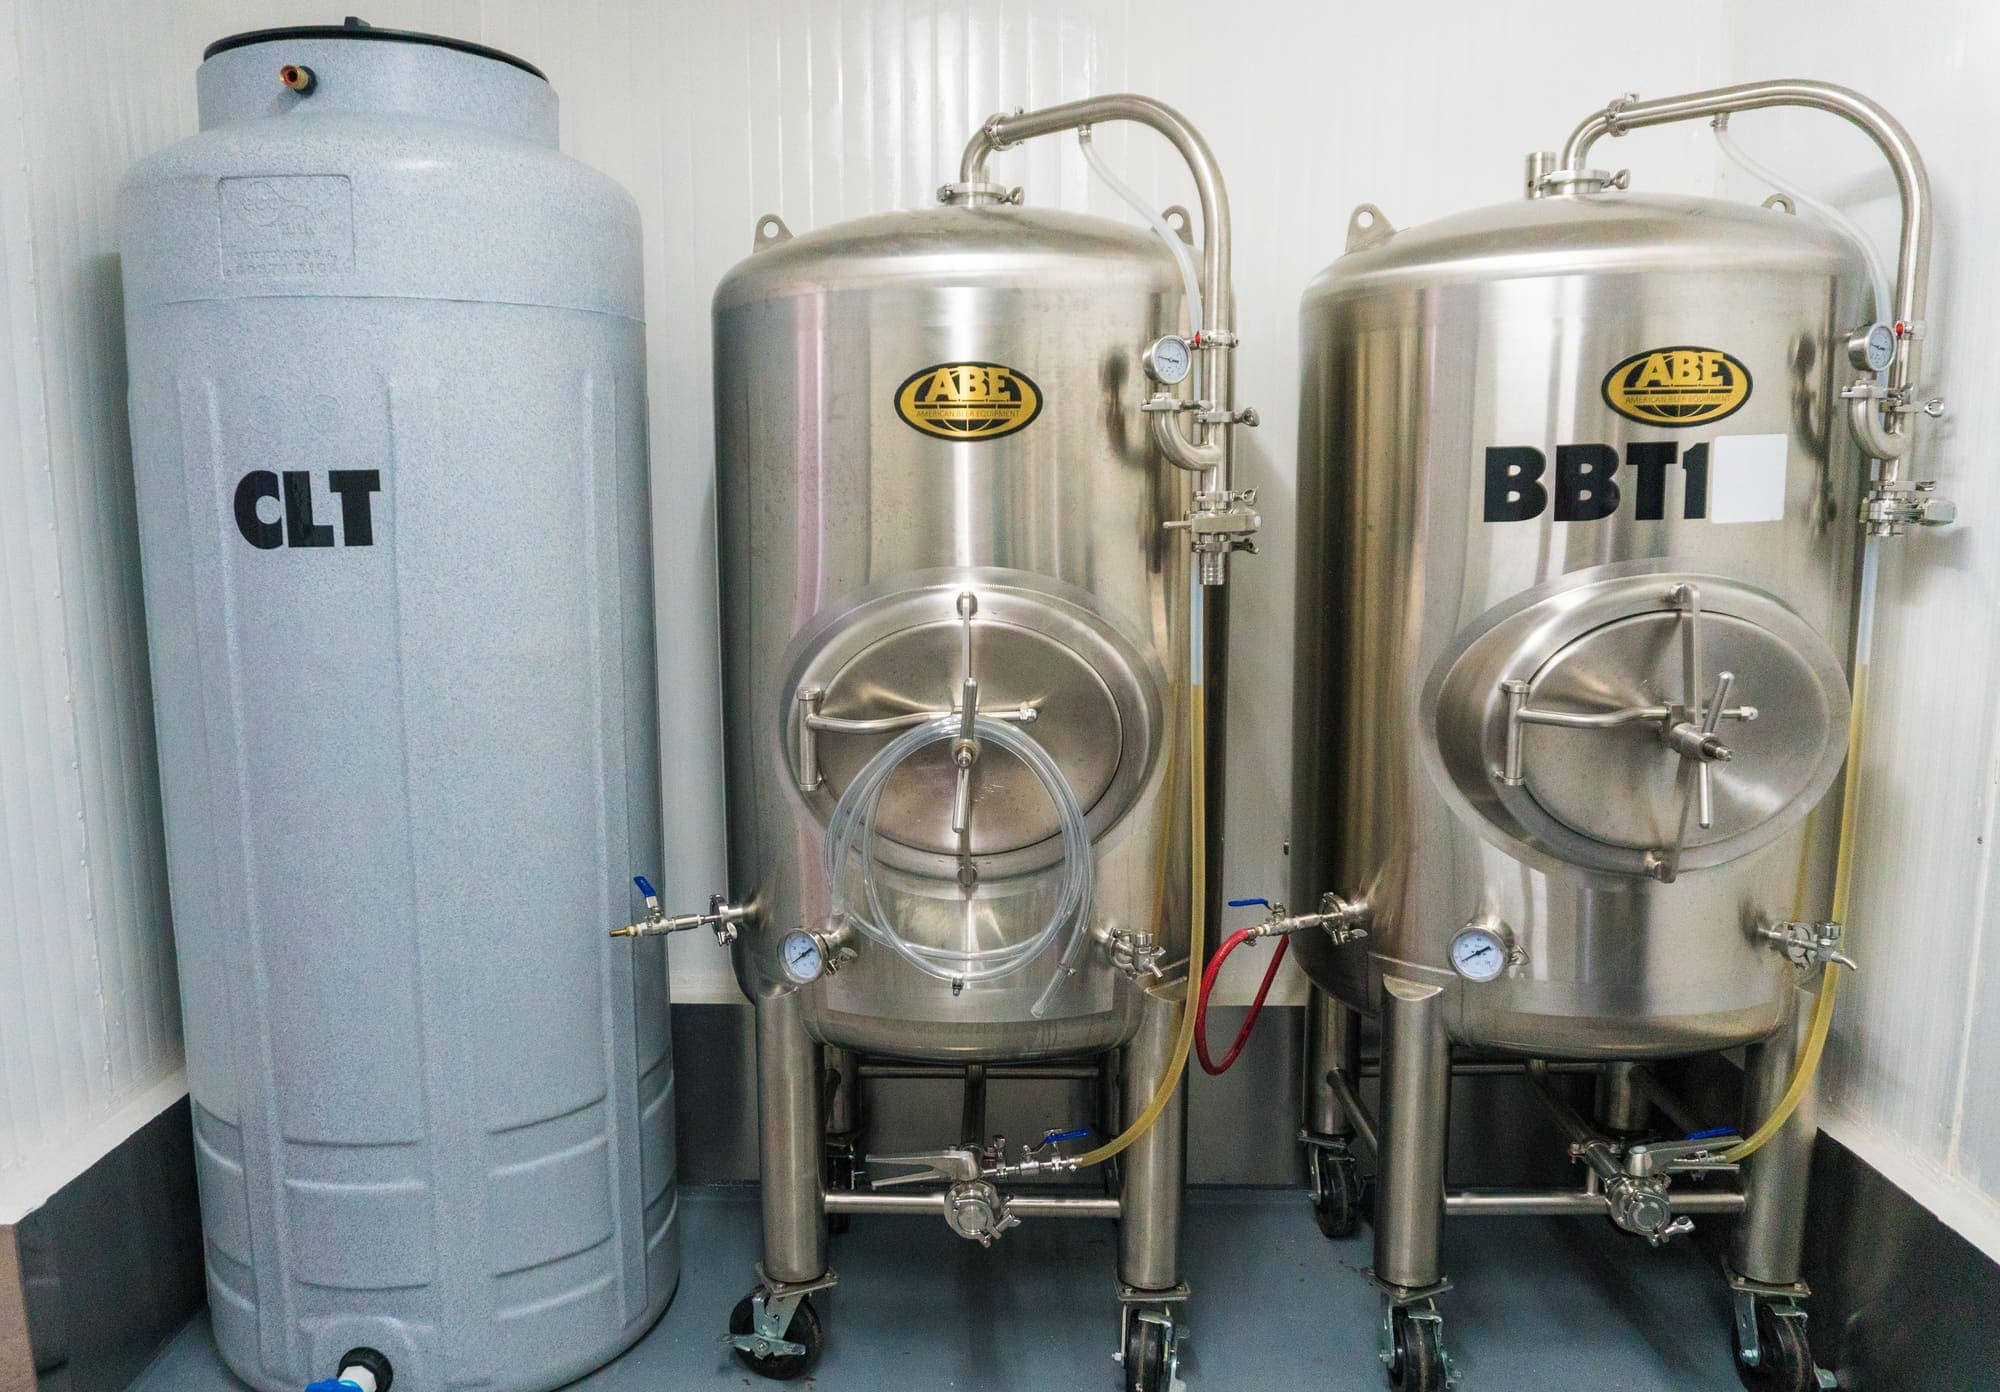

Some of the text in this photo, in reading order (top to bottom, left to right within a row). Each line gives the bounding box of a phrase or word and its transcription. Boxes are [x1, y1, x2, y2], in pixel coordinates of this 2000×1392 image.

[925, 366, 1011, 403] ABE
[1635, 350, 1724, 388] ABE
[916, 409, 955, 418] AMERICAN
[976, 409, 1020, 418] EQUIPMENT
[1484, 441, 1710, 523] BBT1
[234, 469, 381, 550] CLT
